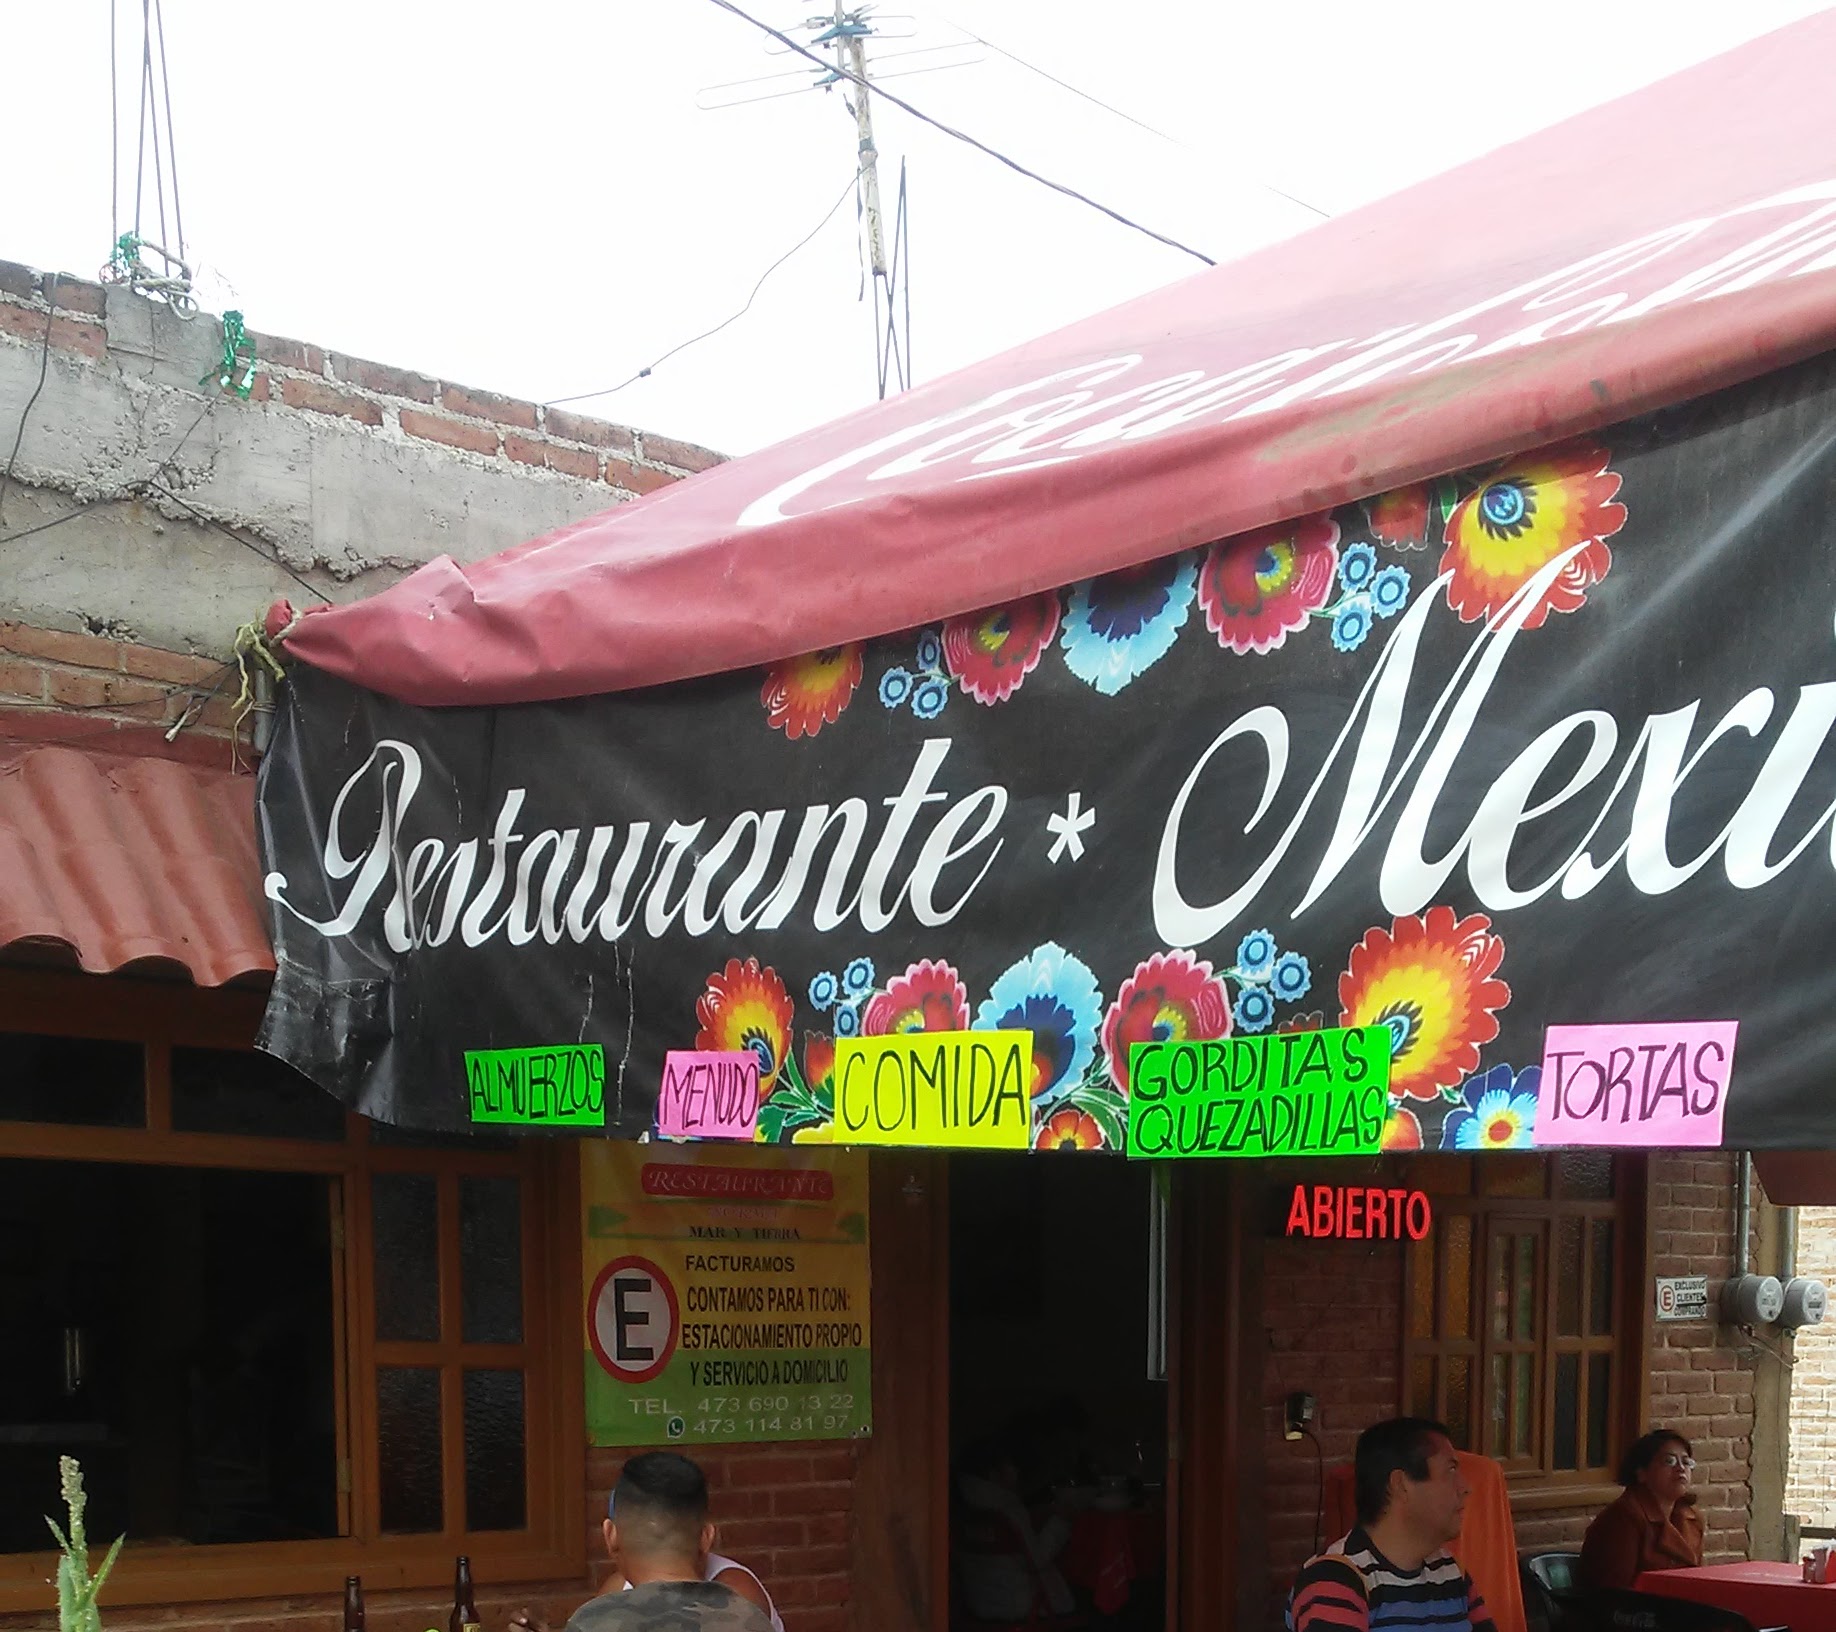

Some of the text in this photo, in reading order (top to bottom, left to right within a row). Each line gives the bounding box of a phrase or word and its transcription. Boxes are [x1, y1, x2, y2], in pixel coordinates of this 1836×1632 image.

[265, 540, 1836, 953] Restaurante Mexi
[471, 1049, 604, 1119] ALMUERZOS
[1133, 1028, 1369, 1101] GORDITAS
[1546, 1041, 1725, 1124] TORTAS
[663, 1061, 759, 1130] MENUDO
[842, 1043, 1027, 1132] COMIDA
[1135, 1085, 1384, 1154] QUEZADILLAS
[650, 1170, 829, 1194] RESTAURANTE
[689, 1226, 801, 1240] MAR Y TIERRA
[1285, 1184, 1432, 1240] ABIERTO
[685, 1255, 796, 1273] FACTURAMOS
[614, 1278, 654, 1361] E
[687, 1285, 764, 1312] CONTAMOS
[768, 1286, 804, 1312] PARA
[808, 1286, 819, 1312] TI
[1663, 1291, 1671, 1306] E
[682, 1322, 862, 1350] ESTACIONAMIENTO PROPIO
[690, 1358, 848, 1386] Y SERVICIO A DOMICILIO
[628, 1399, 682, 1414] TEL.
[698, 1397, 741, 1413] 473
[749, 1396, 789, 1412] 690
[829, 1394, 854, 1409] 22
[693, 1415, 848, 1434] 473 114 81 97
